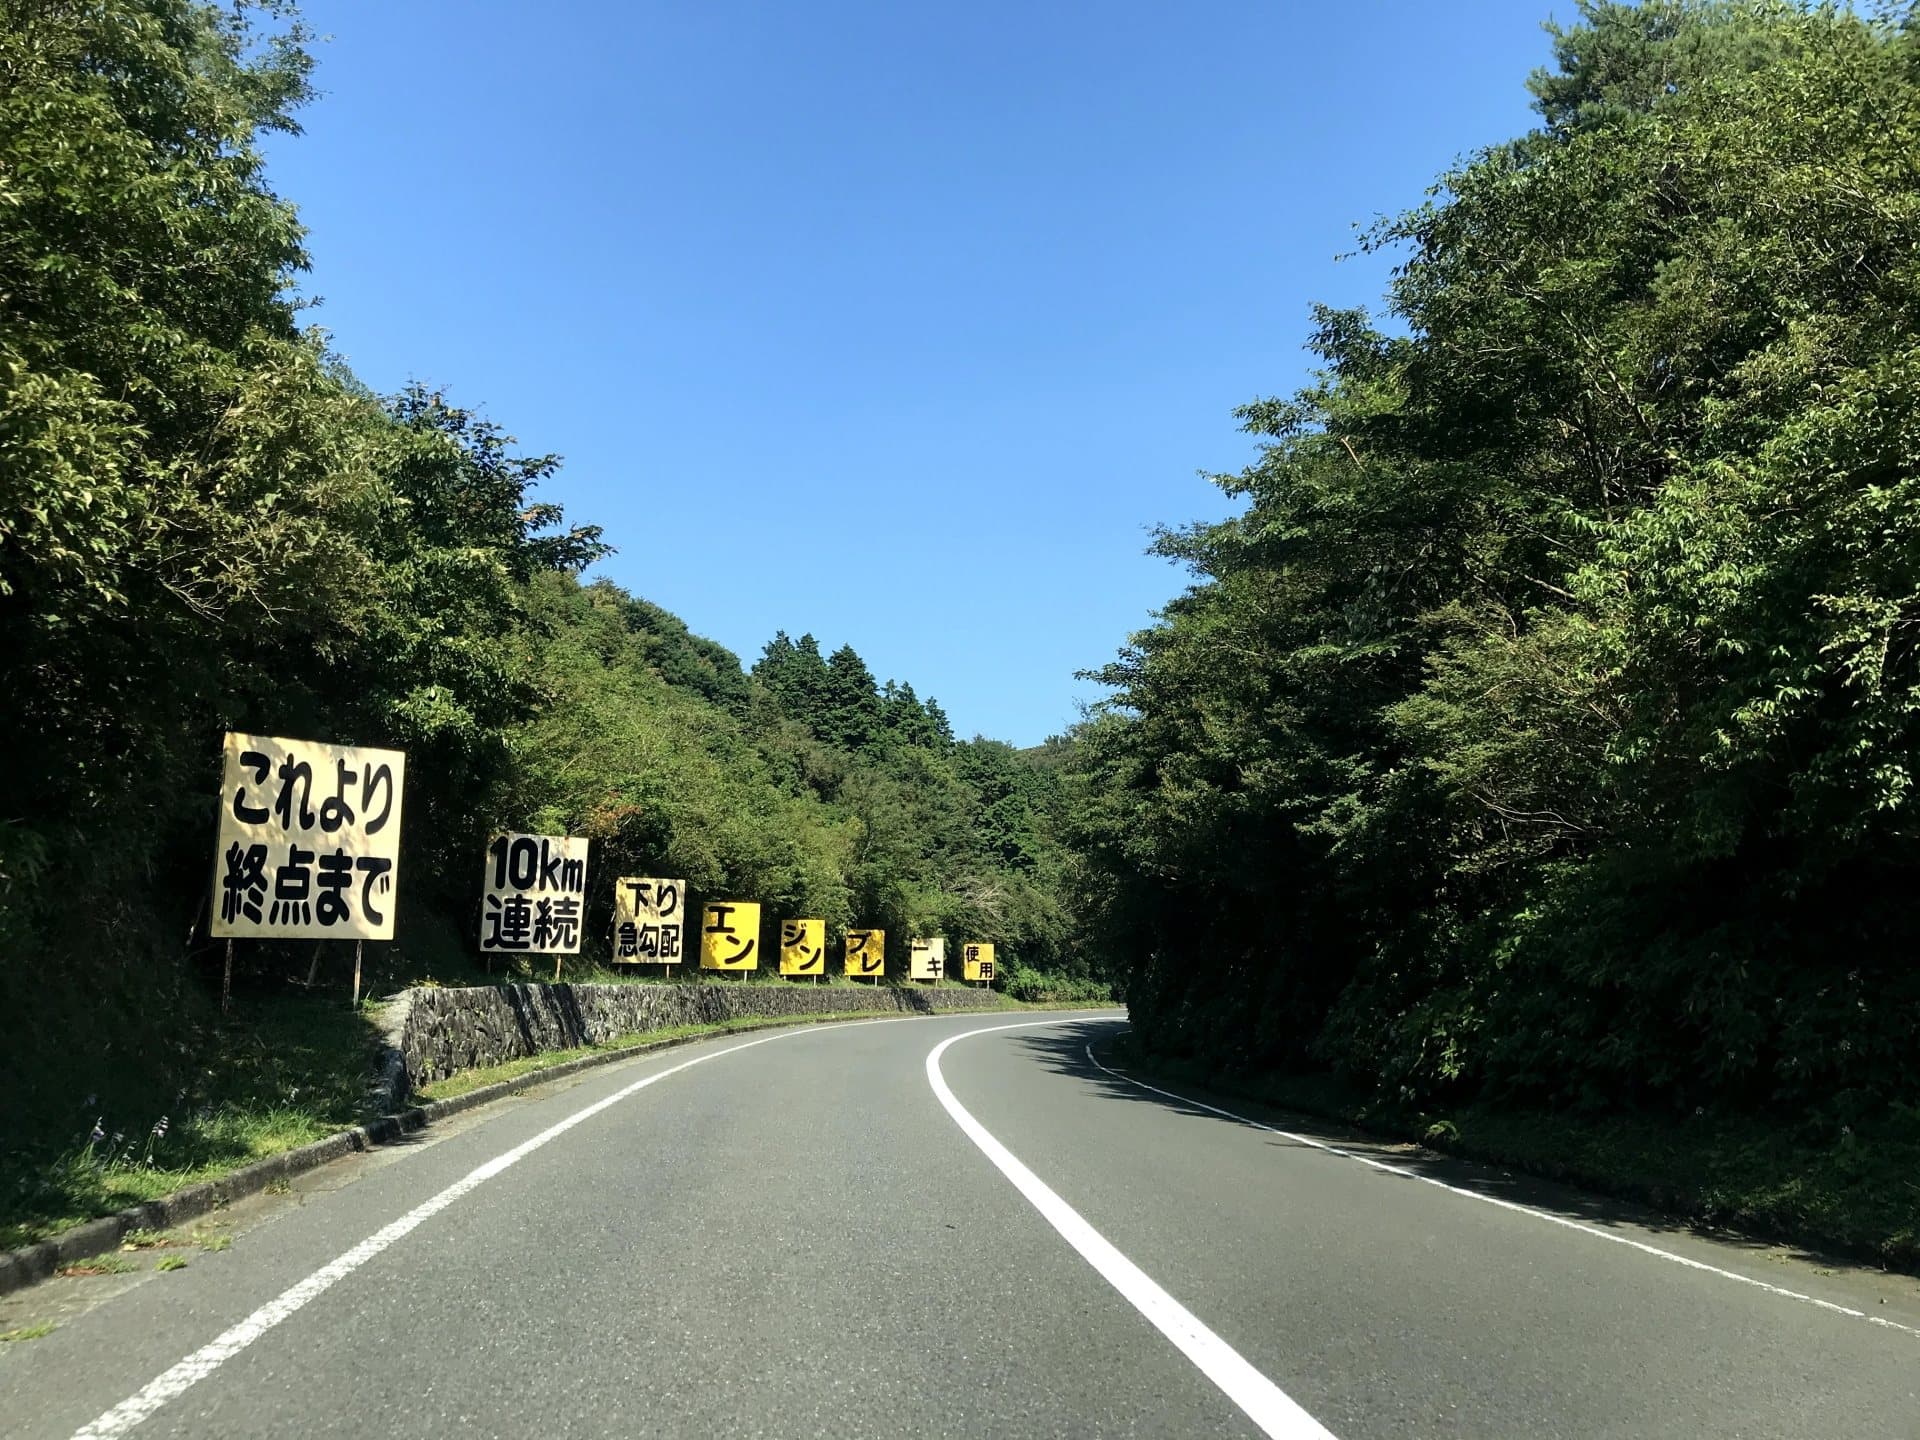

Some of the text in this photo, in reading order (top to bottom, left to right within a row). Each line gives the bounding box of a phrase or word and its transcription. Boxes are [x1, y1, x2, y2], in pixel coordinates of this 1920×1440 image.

[233, 751, 393, 835] これより
[221, 841, 392, 926] 終点まで
[490, 836, 583, 893] 10km
[483, 894, 580, 950] 連続
[626, 883, 677, 917] 下り
[618, 922, 680, 958] 急勾配
